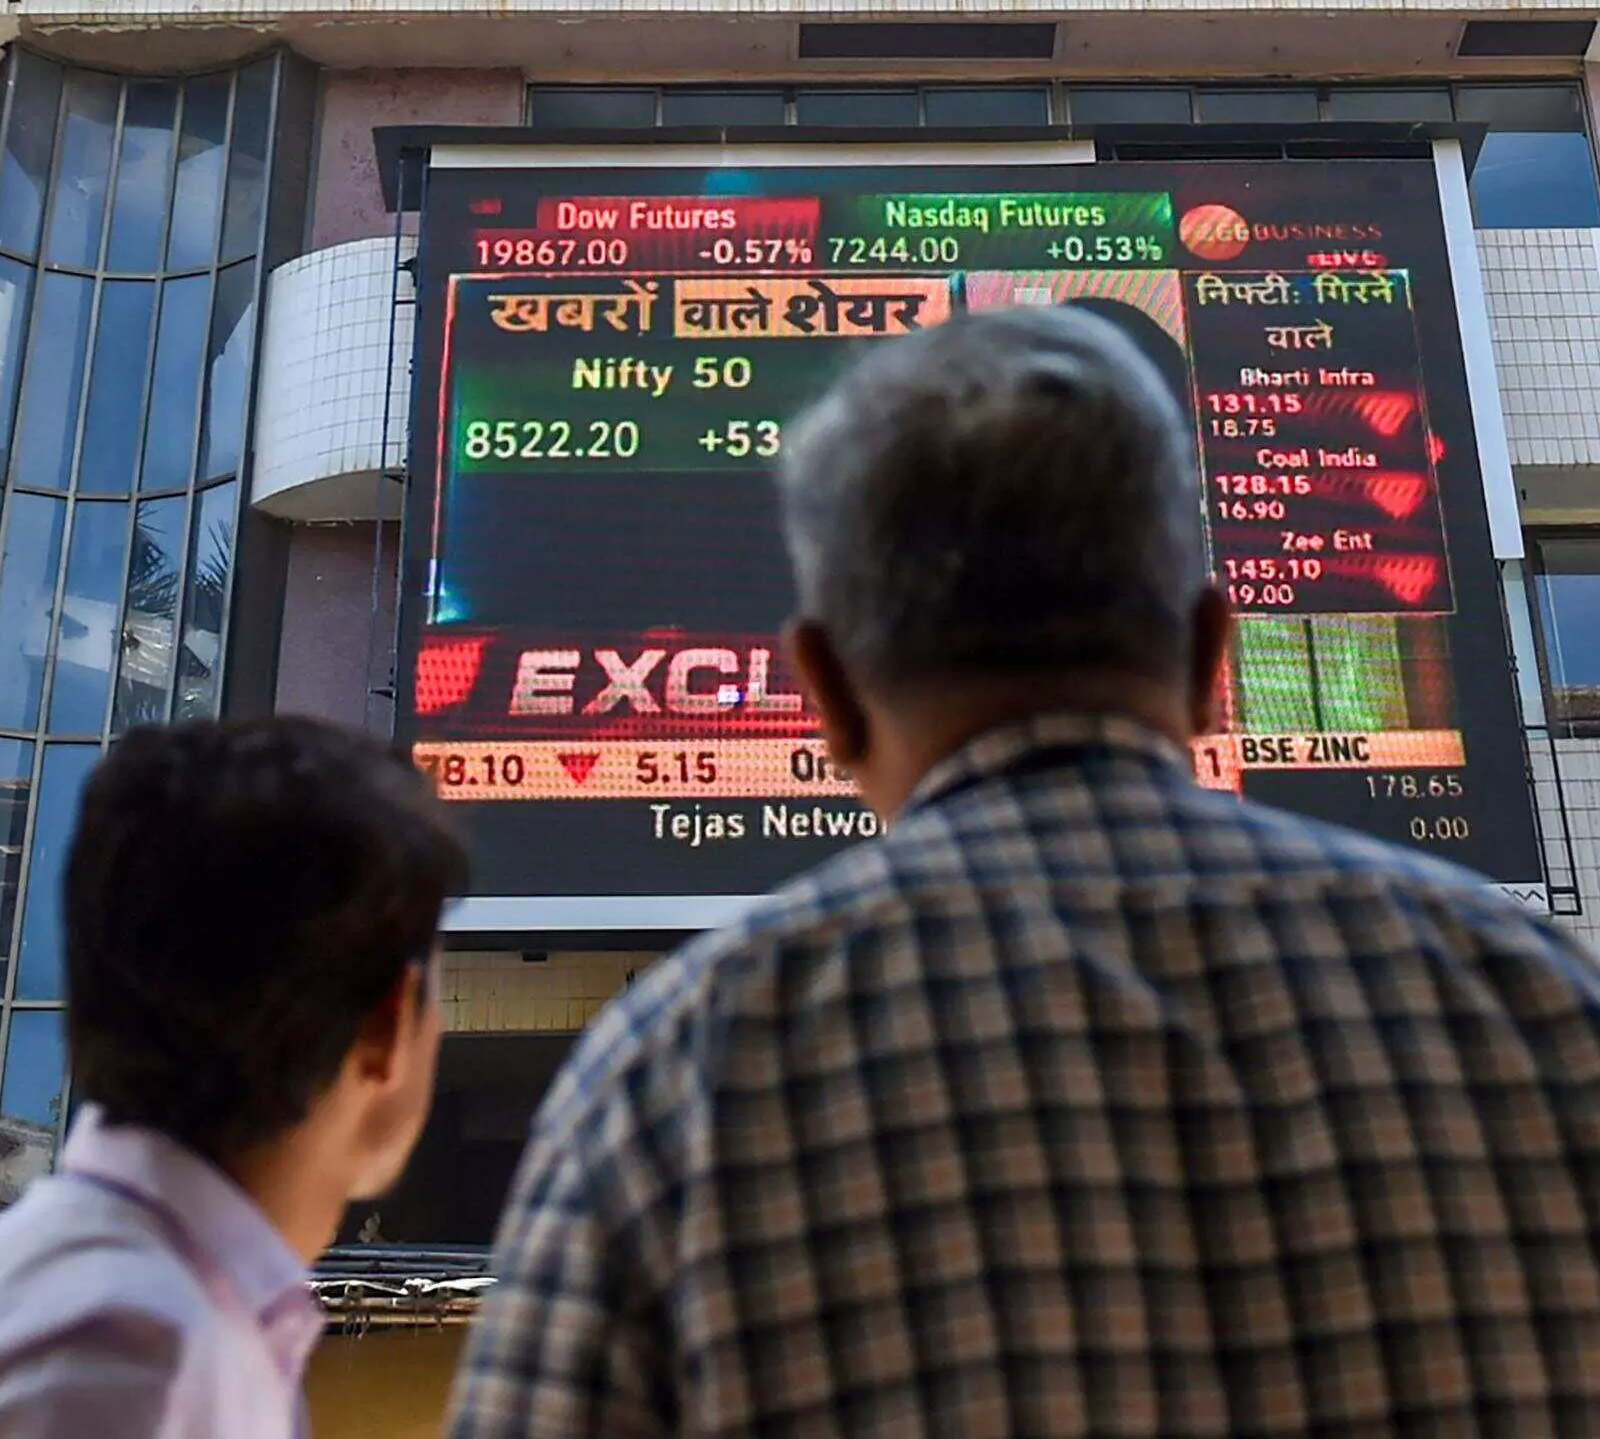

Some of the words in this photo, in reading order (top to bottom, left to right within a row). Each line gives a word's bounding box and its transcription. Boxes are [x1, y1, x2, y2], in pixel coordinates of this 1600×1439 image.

[556, 201, 619, 230] Dow
[630, 201, 737, 230] Futures
[886, 200, 990, 233] Nasdaq
[1000, 201, 1106, 227] Futures
[1253, 222, 1383, 241] BUSINESS
[476, 238, 628, 266] 19867.00
[700, 237, 813, 265] -0.57%
[828, 237, 960, 264] 7244.00
[1046, 235, 1164, 262] +0.53%
[1313, 269, 1397, 305] गिरने
[486, 279, 660, 337] खबरों
[680, 286, 773, 332] वाले
[781, 280, 929, 335] शेयर
[1264, 318, 1335, 350] वाले
[571, 357, 674, 398] Nifty
[692, 356, 753, 390] 50
[1240, 367, 1311, 388] Bharti
[1319, 367, 1377, 387] Infra
[1208, 393, 1303, 415] 131.15
[464, 420, 640, 460] 8522.20
[1210, 418, 1277, 439] 18.75
[1256, 448, 1311, 468] Coal
[1318, 448, 1378, 468] India
[1216, 474, 1313, 496] 128.15
[1218, 500, 1286, 521] 16.90
[1281, 530, 1325, 552] Zee
[1333, 529, 1374, 551] Ent
[1225, 558, 1322, 581] 145.10
[1228, 584, 1296, 606] 19.00
[507, 648, 803, 716] EXCL
[1241, 737, 1299, 764] BSE
[1305, 735, 1371, 764] ZINC
[636, 750, 718, 784] 5.15
[1366, 774, 1464, 800] 178.65
[650, 804, 745, 847] Tejas
[1410, 816, 1470, 840] 0.00
